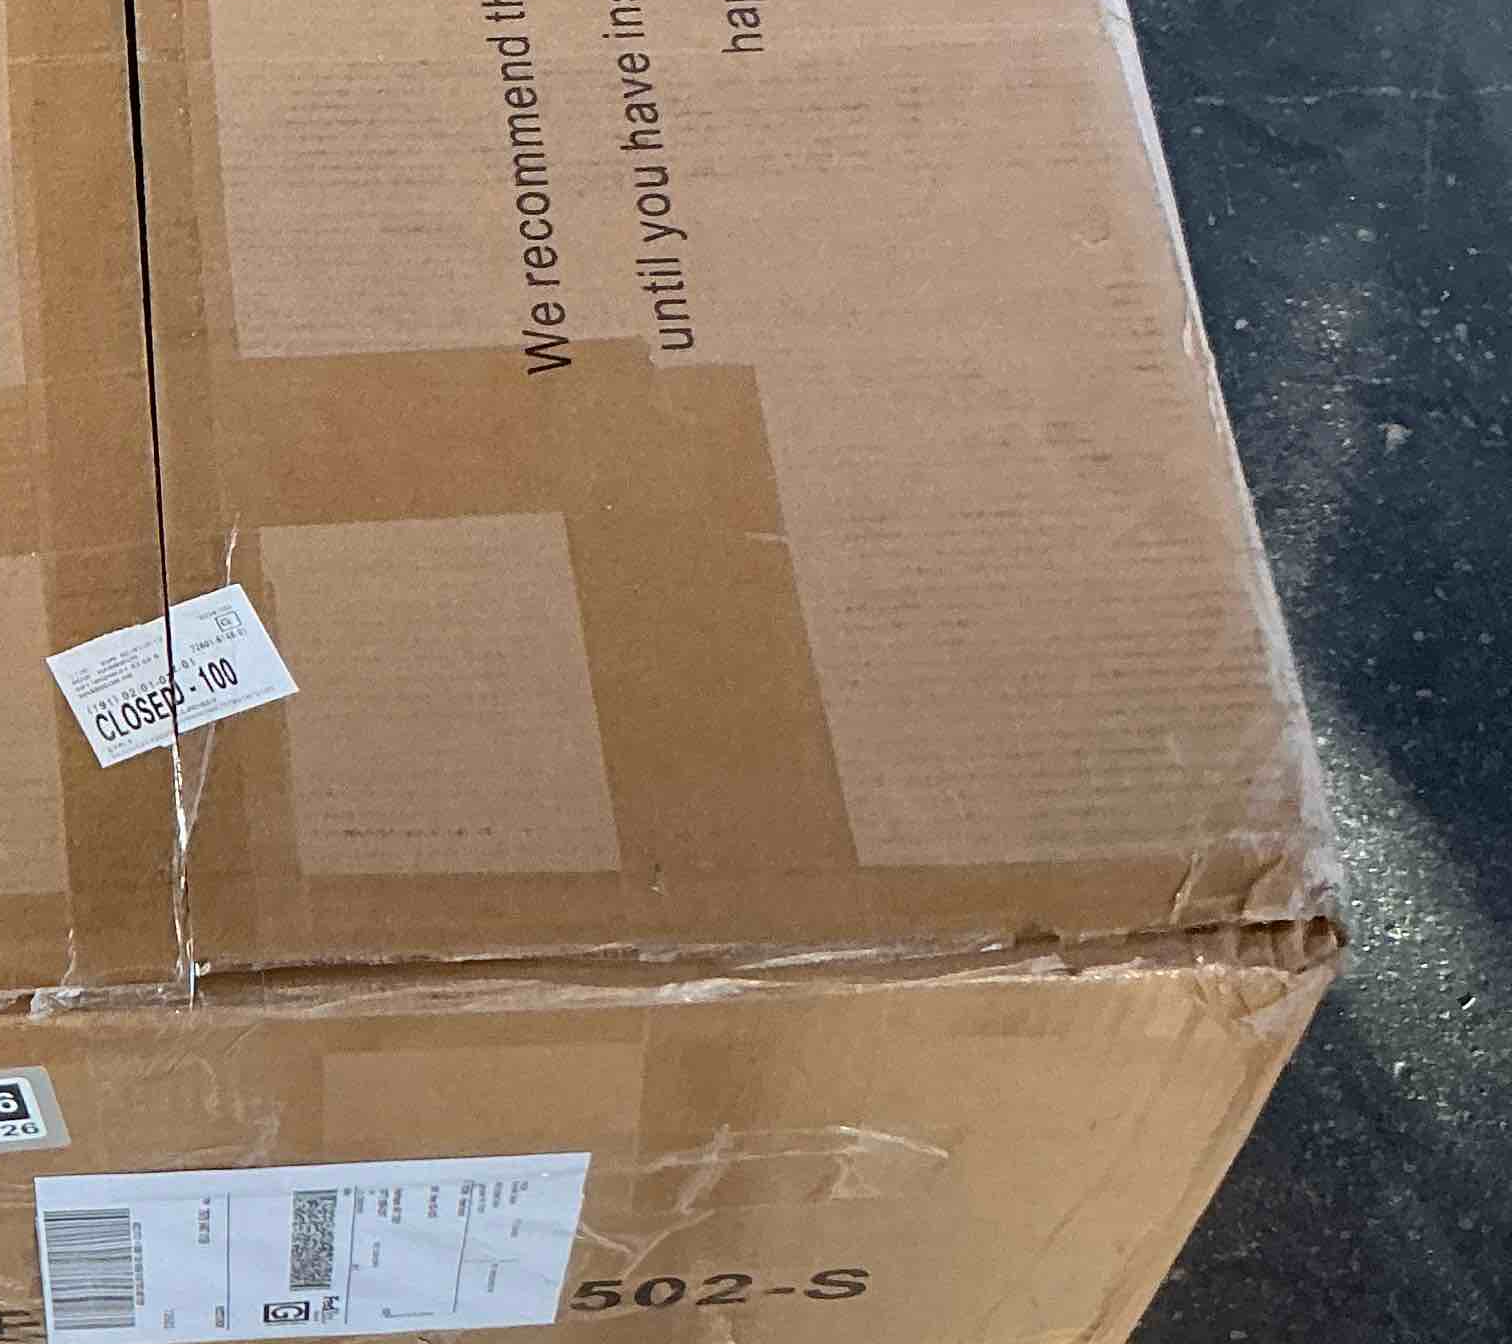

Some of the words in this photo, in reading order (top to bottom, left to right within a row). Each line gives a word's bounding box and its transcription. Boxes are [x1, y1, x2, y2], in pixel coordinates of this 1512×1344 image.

[617, 53, 664, 151] have
[486, 37, 560, 286] recommend
[634, 166, 688, 243] you
[522, 302, 572, 375] We
[635, 258, 694, 350] until
[95, 680, 185, 742] CLOSED
[198, 657, 239, 696] 100
